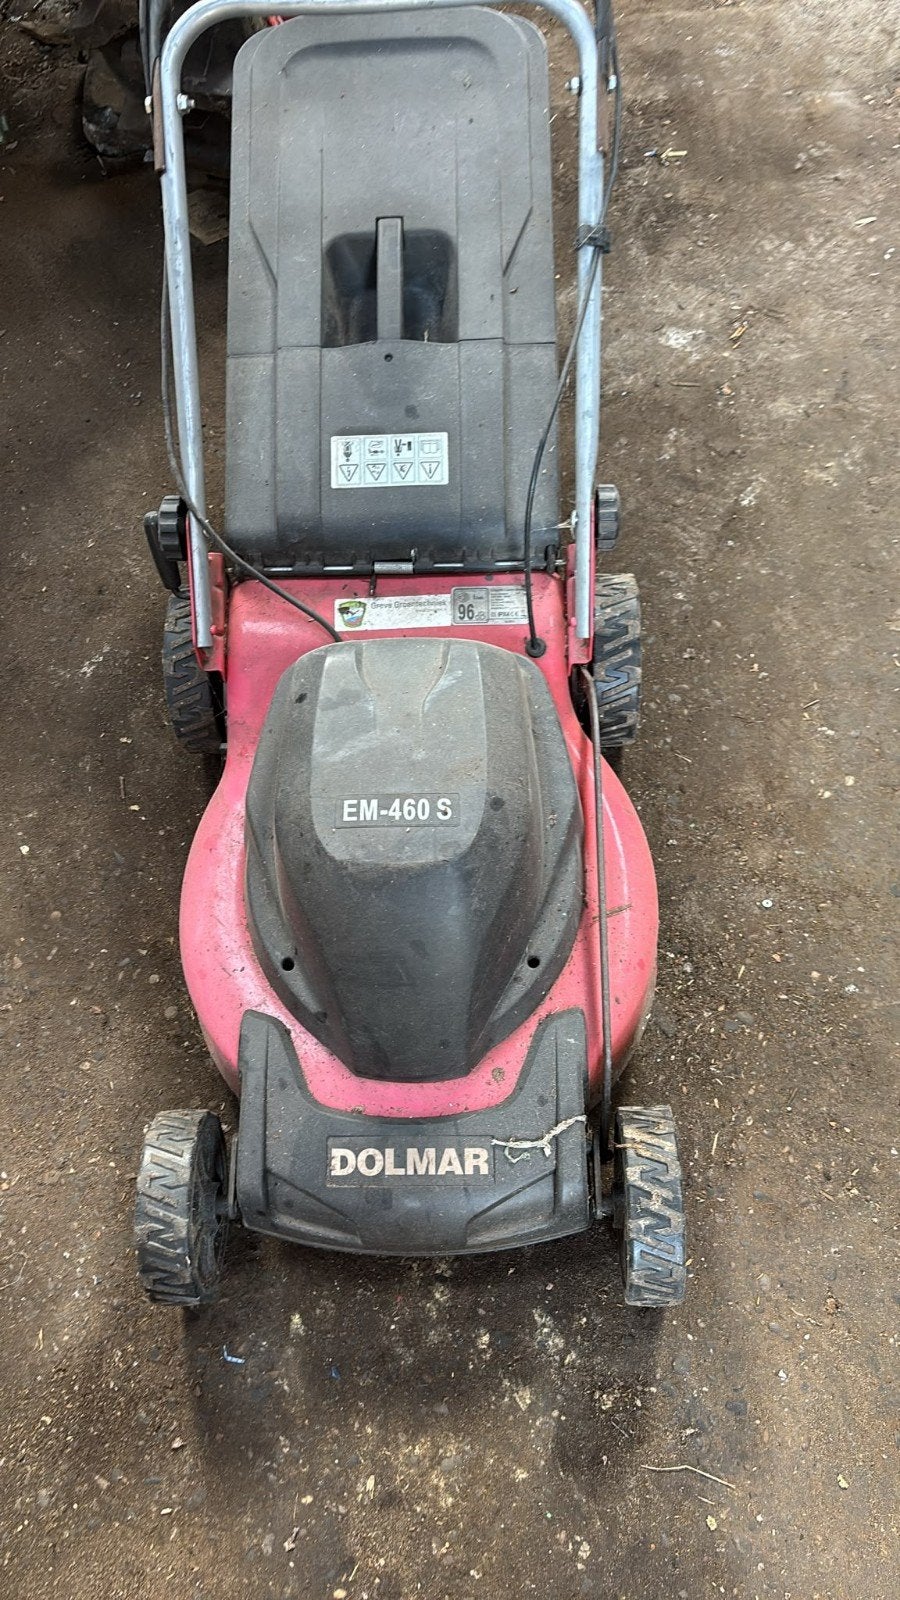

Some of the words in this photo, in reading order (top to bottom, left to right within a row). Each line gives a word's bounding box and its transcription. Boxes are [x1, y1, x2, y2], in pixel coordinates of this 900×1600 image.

[458, 603, 475, 620] 96
[342, 798, 430, 821] EM-460
[437, 798, 452, 820] S
[331, 1147, 489, 1177] DOLMAR
